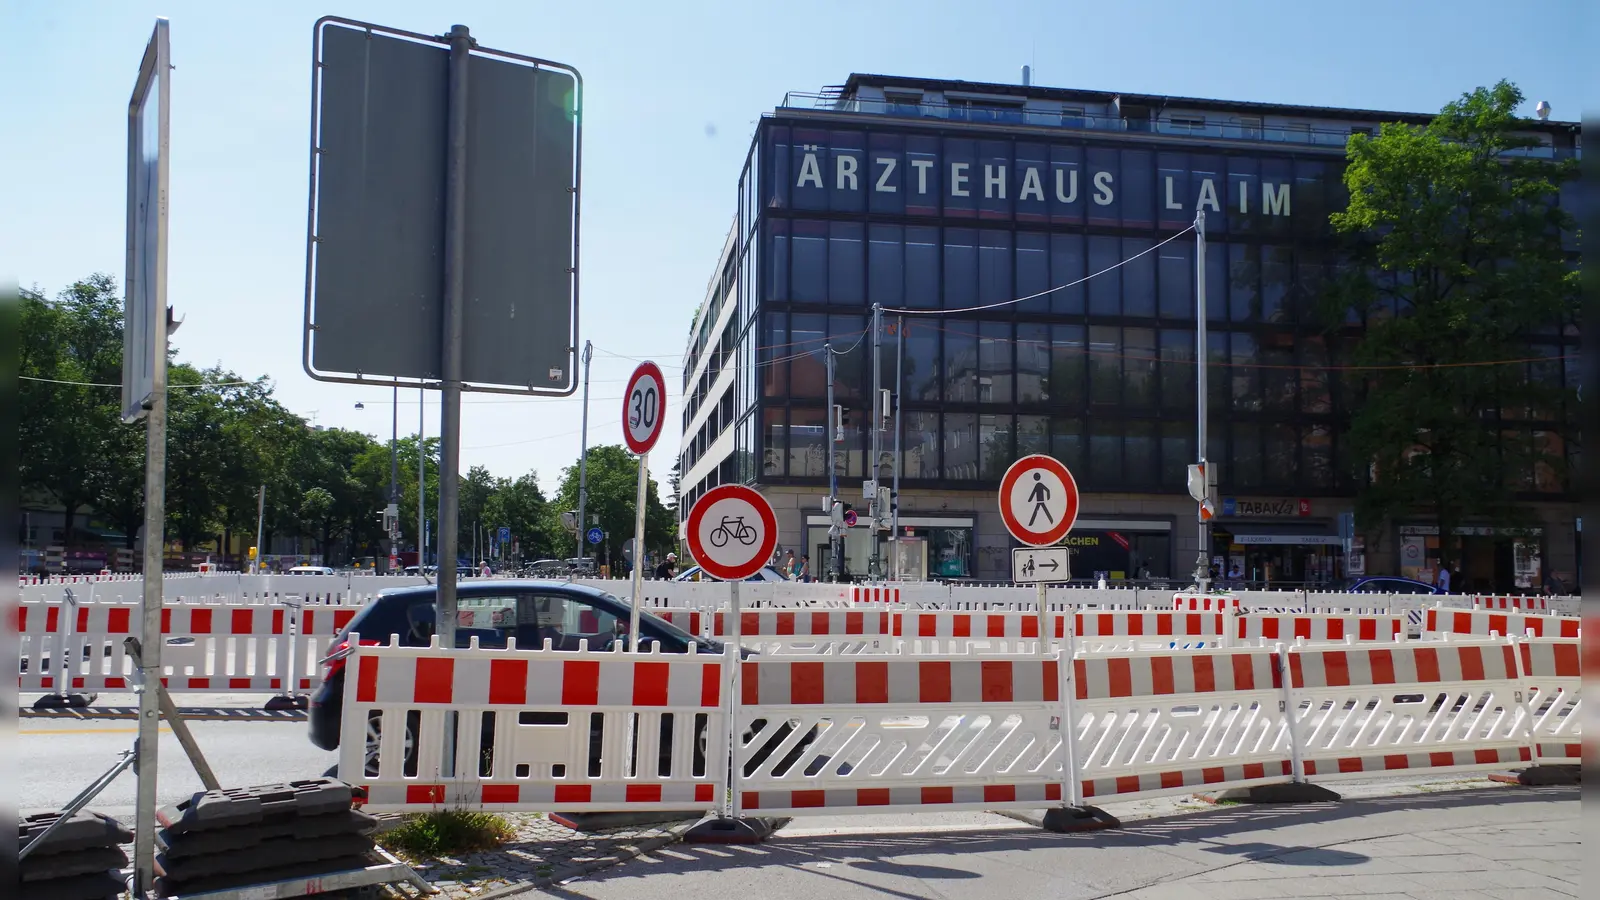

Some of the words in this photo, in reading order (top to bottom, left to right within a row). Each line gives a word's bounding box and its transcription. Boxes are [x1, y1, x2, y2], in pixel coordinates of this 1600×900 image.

[796, 144, 1114, 206] ÄRZTEHAUS
[1165, 175, 1291, 217] LAIM
[631, 387, 656, 429] 30
